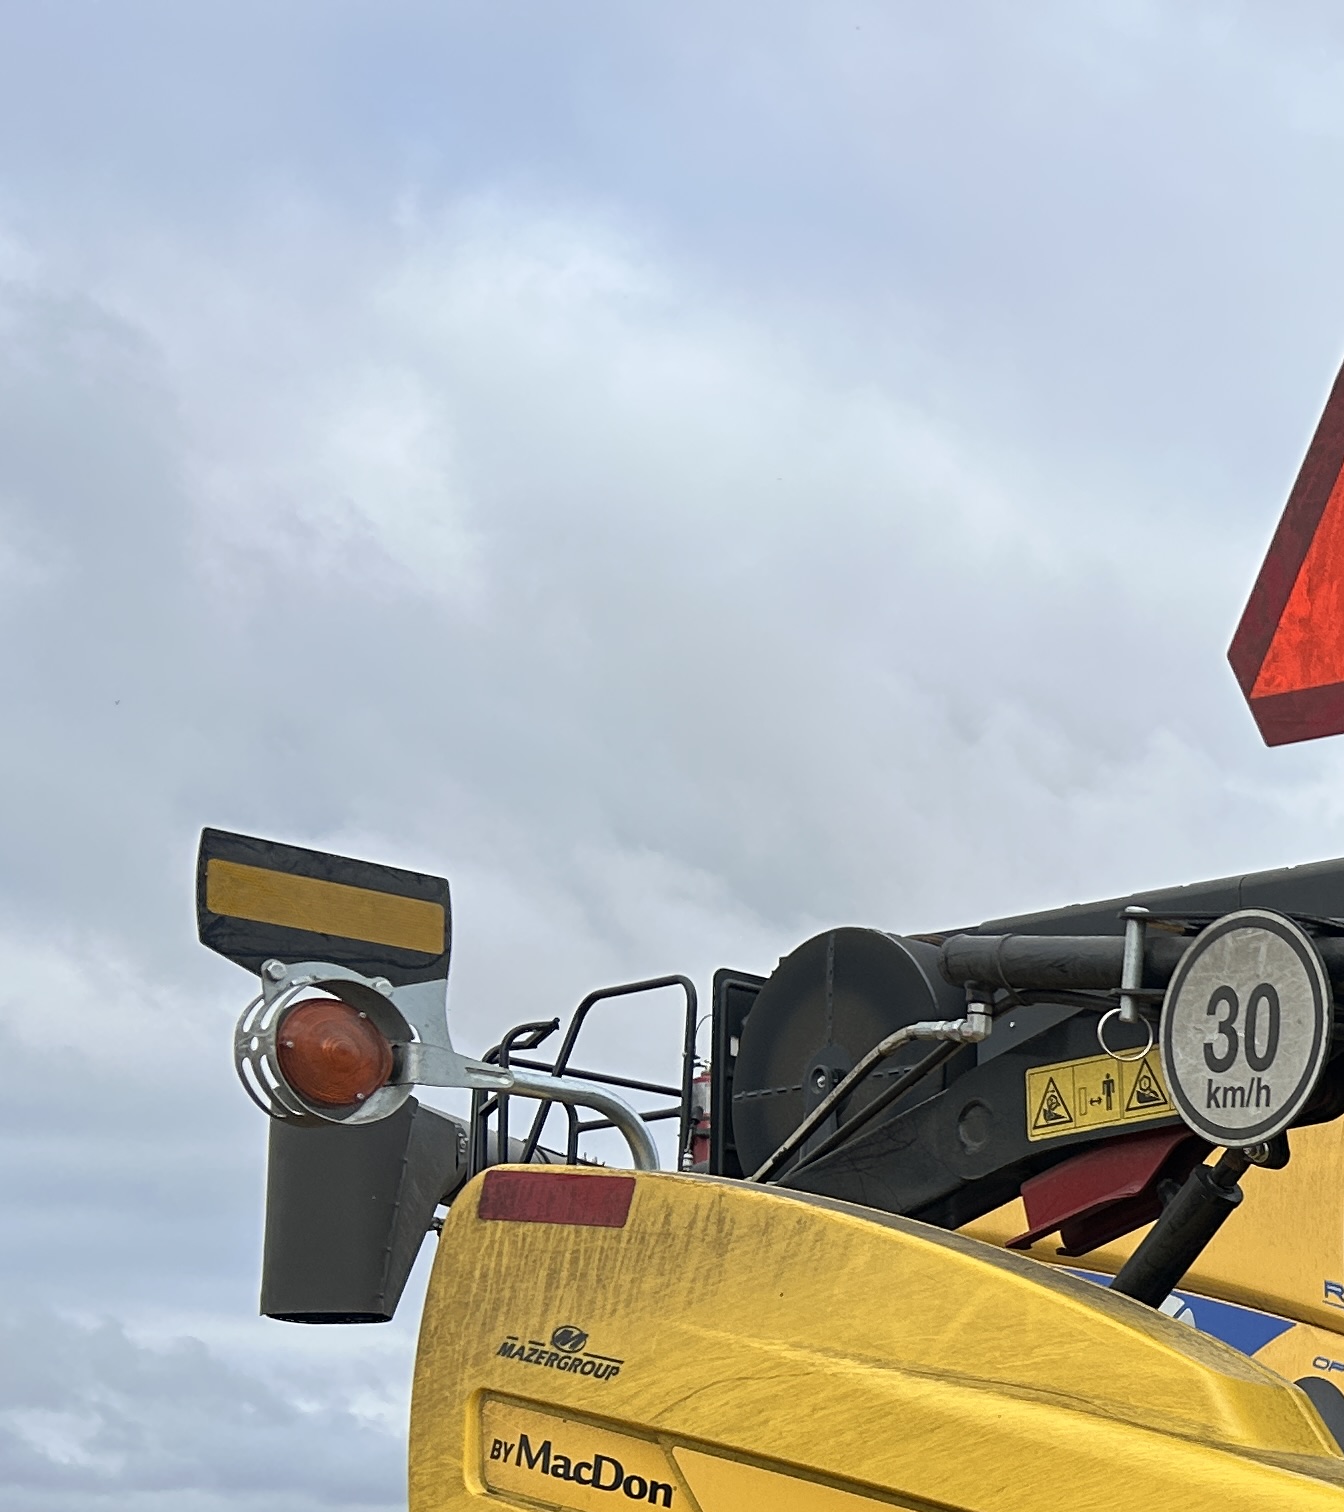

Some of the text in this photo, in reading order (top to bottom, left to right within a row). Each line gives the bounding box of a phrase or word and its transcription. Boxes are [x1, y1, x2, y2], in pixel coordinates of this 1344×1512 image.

[1203, 984, 1280, 1073] 30
[1206, 1079, 1271, 1108] km/h
[496, 1341, 620, 1381] MAZERGROUP
[490, 1433, 673, 1508] BY MacDon
